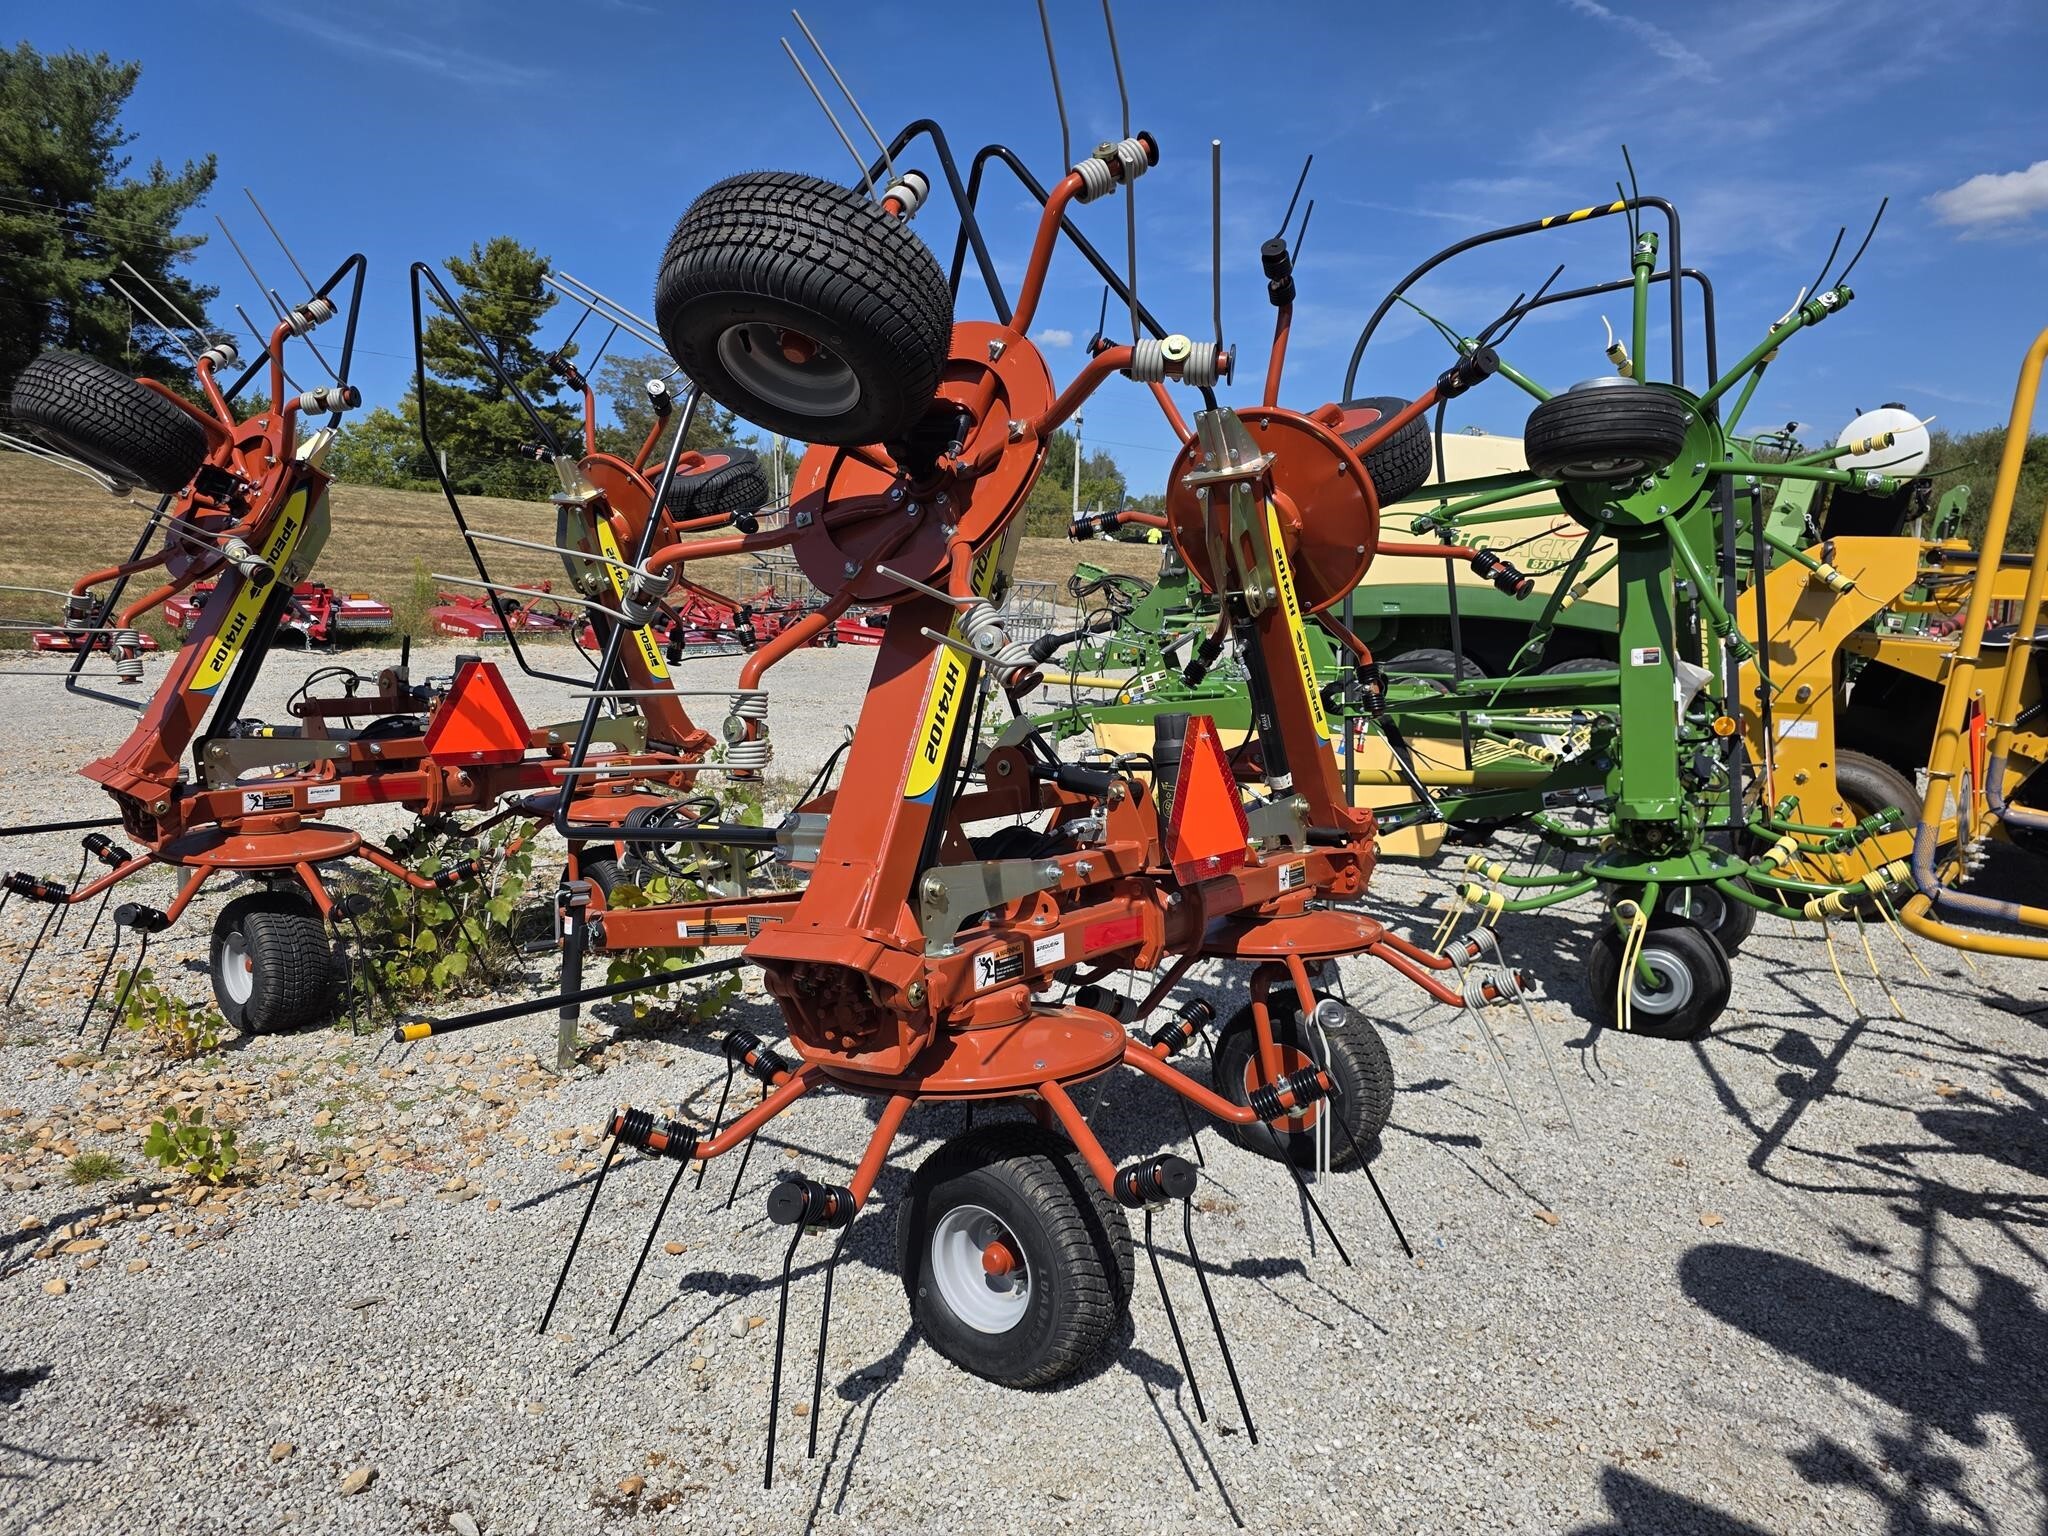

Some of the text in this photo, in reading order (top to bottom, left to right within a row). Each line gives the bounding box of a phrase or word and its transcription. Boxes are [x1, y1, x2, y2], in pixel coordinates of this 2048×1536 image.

[1275, 548, 1296, 617] HT4102
[1530, 560, 1555, 569] 870
[209, 611, 248, 672] HT4102
[1297, 637, 1322, 719] PEQUEA
[924, 661, 960, 765] HT4102
